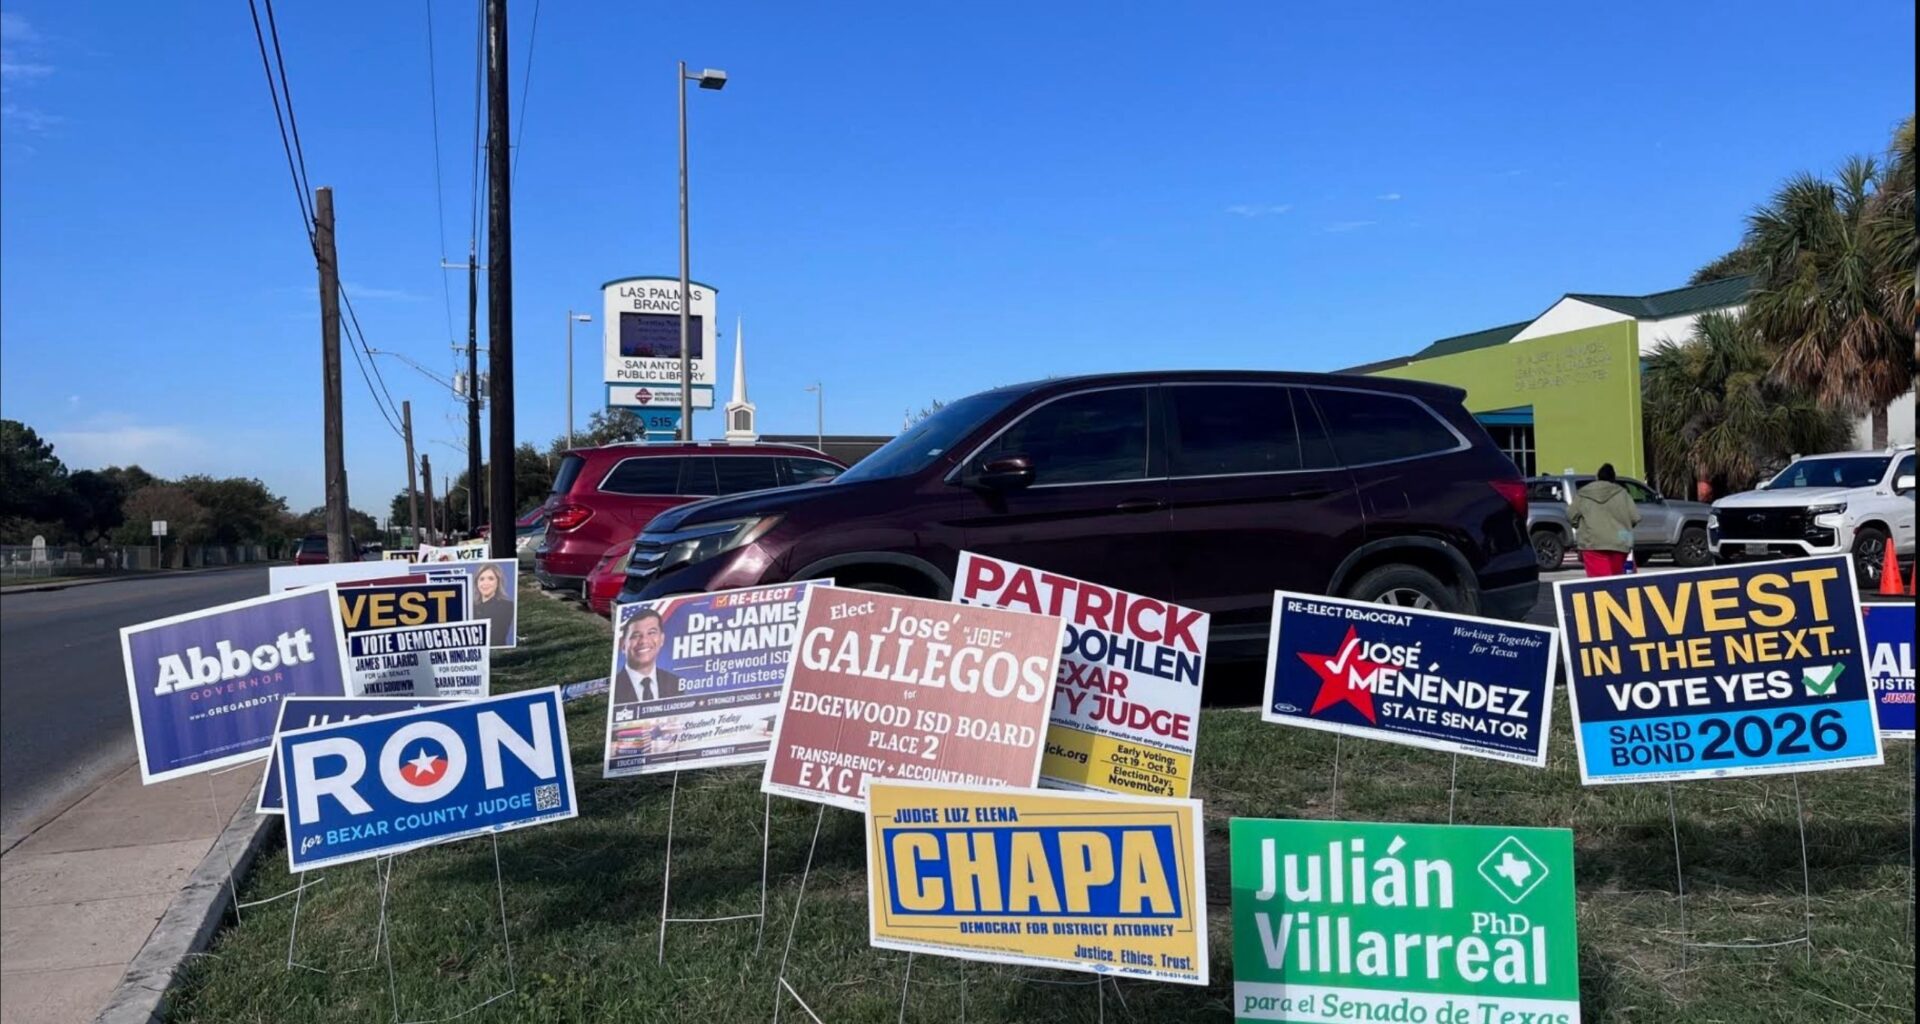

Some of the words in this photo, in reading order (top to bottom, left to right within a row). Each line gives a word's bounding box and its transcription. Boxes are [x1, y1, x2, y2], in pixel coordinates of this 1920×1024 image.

[620, 287, 645, 298] LAS
[634, 299, 680, 311] BRANC
[617, 370, 656, 380] PUBLIC
[659, 371, 705, 381] LIBRRY
[625, 360, 647, 369] SAN
[650, 361, 698, 371] ANTOO
[651, 417, 672, 427] 515
[456, 548, 483, 560] VOTE
[728, 588, 792, 606] RE-ELECT
[963, 555, 1204, 654] PATRICK
[1571, 567, 1839, 643] INVEST
[830, 600, 876, 621] Elect
[1287, 601, 1343, 618] RE-ELECT
[1345, 608, 1413, 628] DEMOCRAT
[688, 613, 722, 633] Dr.
[361, 633, 394, 655] VOTE
[396, 626, 483, 651] DEMOCRATIC!
[1453, 626, 1495, 643] Working
[1497, 633, 1543, 649] Together
[154, 628, 315, 696] Abbott
[355, 656, 380, 672] JAMES
[382, 653, 419, 670] TALARICO
[429, 650, 449, 665] GINA
[449, 648, 482, 664] HINOJOSA
[705, 652, 767, 674] Edgewood
[770, 650, 790, 665] ISD
[1357, 641, 1422, 670] JOSÉ
[1469, 642, 1487, 655] for
[1488, 645, 1519, 659] Texas
[1579, 646, 1623, 678] IN
[1629, 637, 1716, 673] THE
[1725, 626, 1851, 666] NEXT...
[801, 626, 1050, 704] GALLEGOS
[190, 672, 284, 701] GOVERNOR
[678, 674, 714, 691] Board
[716, 673, 728, 686] of
[731, 668, 785, 685] Trustees
[1348, 662, 1530, 718] MENÉNDEZ
[1605, 677, 1712, 712] VOTE
[1713, 670, 1794, 704] YES
[663, 701, 696, 712] LEADERSHIP
[707, 695, 735, 706] STRONGER
[736, 692, 762, 702] SCHOOLS
[903, 690, 917, 700] for
[790, 690, 912, 728] EDGEWOOD
[914, 712, 952, 737] ISD
[955, 719, 1036, 749] BOARD
[1089, 694, 1191, 741] JUDGE
[1381, 702, 1438, 724] STATE
[1441, 712, 1529, 740] SENATOR
[868, 730, 920, 756] PLACE
[921, 734, 940, 761] 2
[1085, 723, 1108, 735] Deliver
[1143, 737, 1164, 748] empty
[1164, 742, 1193, 754] promises
[1609, 721, 1692, 746] SAISD
[1698, 709, 1848, 762] 2026
[291, 701, 557, 825] RON
[790, 744, 887, 774] TRANSPARENCY
[1111, 753, 1128, 764] Oct
[1129, 757, 1140, 766] 19
[1147, 761, 1164, 773] Oct
[1165, 766, 1177, 775] 30
[1117, 744, 1141, 758] Early
[1143, 750, 1176, 765] Voting:
[1611, 744, 1696, 768] BOND
[1108, 774, 1165, 796] November
[1167, 787, 1174, 797] 3
[1113, 766, 1150, 782] Election
[1151, 774, 1172, 787] Day:
[300, 834, 323, 856] for
[326, 820, 390, 846] BEXAR
[394, 804, 470, 831] COUNTY
[474, 793, 533, 816] JUDGE
[893, 807, 939, 824] JUDGE
[944, 808, 969, 823] LUZ
[976, 807, 1019, 823] ELENA
[892, 830, 1176, 914] CHAPA
[1255, 835, 1454, 909] Julián
[959, 921, 1022, 935] DEMOCRAT
[1026, 923, 1049, 935] FOR
[1053, 923, 1108, 936] DISTRICT
[1113, 924, 1174, 938] ATTORNEY
[1471, 911, 1530, 935] PhD
[1074, 944, 1117, 962] Justice.
[1121, 949, 1157, 967] Ethics.
[1160, 953, 1194, 971] Trust.
[1254, 911, 1547, 985] Villarreal
[1243, 994, 1293, 1013] para
[1298, 995, 1316, 1013] el
[1321, 993, 1428, 1023] Senado
[1434, 1001, 1470, 1024] de
[1477, 1002, 1569, 1024] Texas
